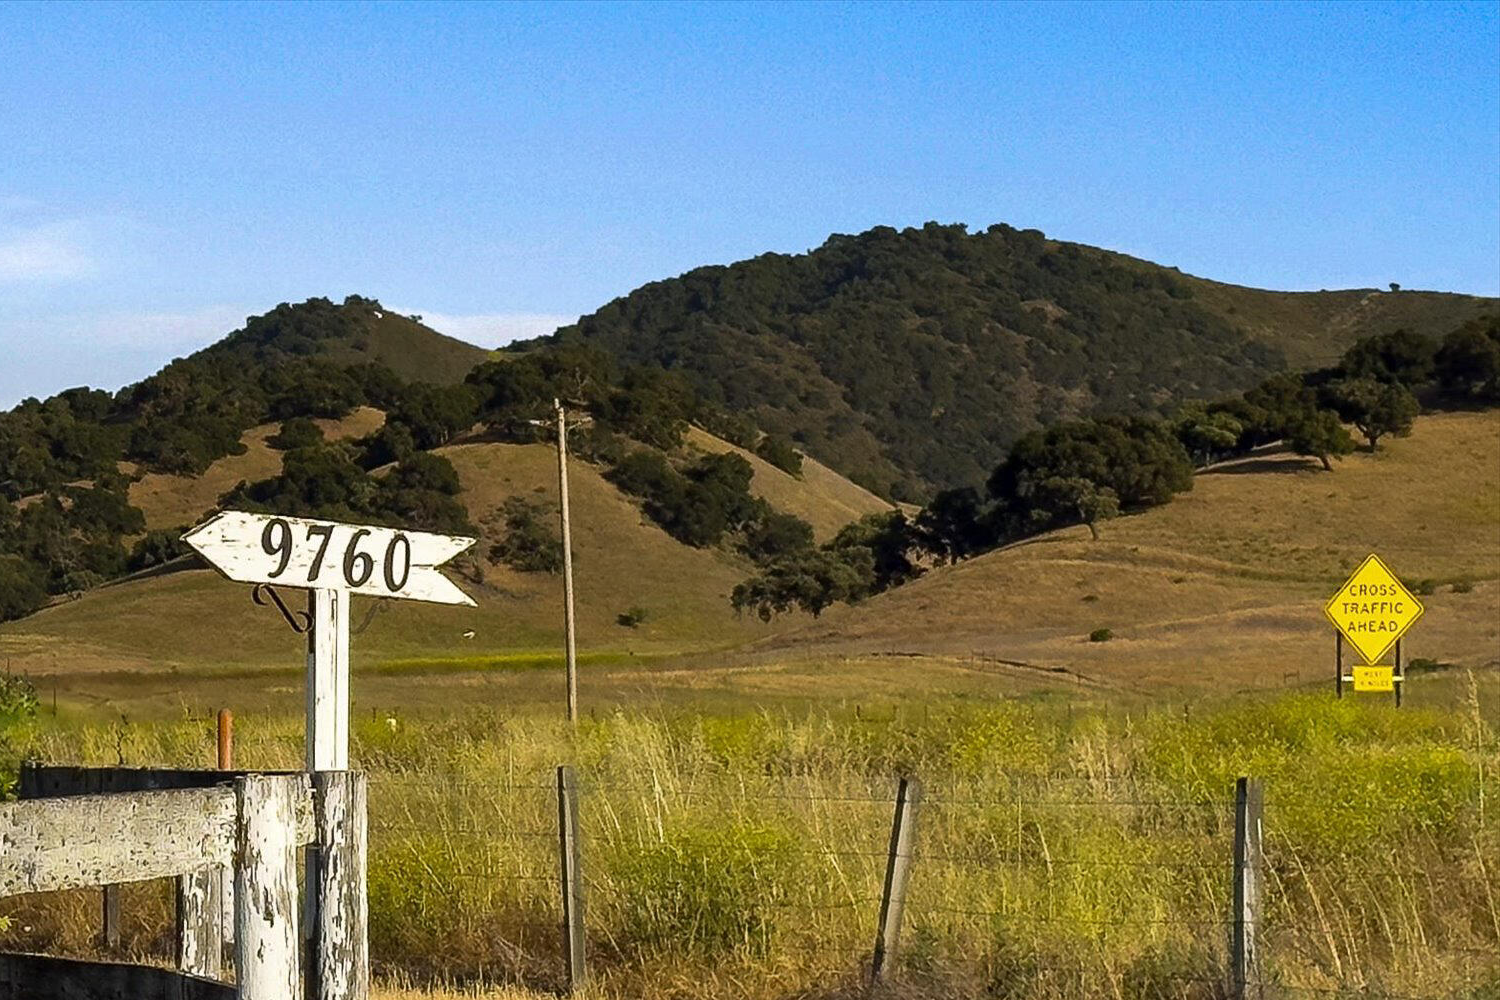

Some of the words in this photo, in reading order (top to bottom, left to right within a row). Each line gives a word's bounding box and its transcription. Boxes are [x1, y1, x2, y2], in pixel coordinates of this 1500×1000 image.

[261, 517, 411, 592] 9760
[1349, 584, 1397, 597] CROSS
[1342, 602, 1404, 615] TRAFFIC
[1347, 620, 1399, 633] AHEAD
